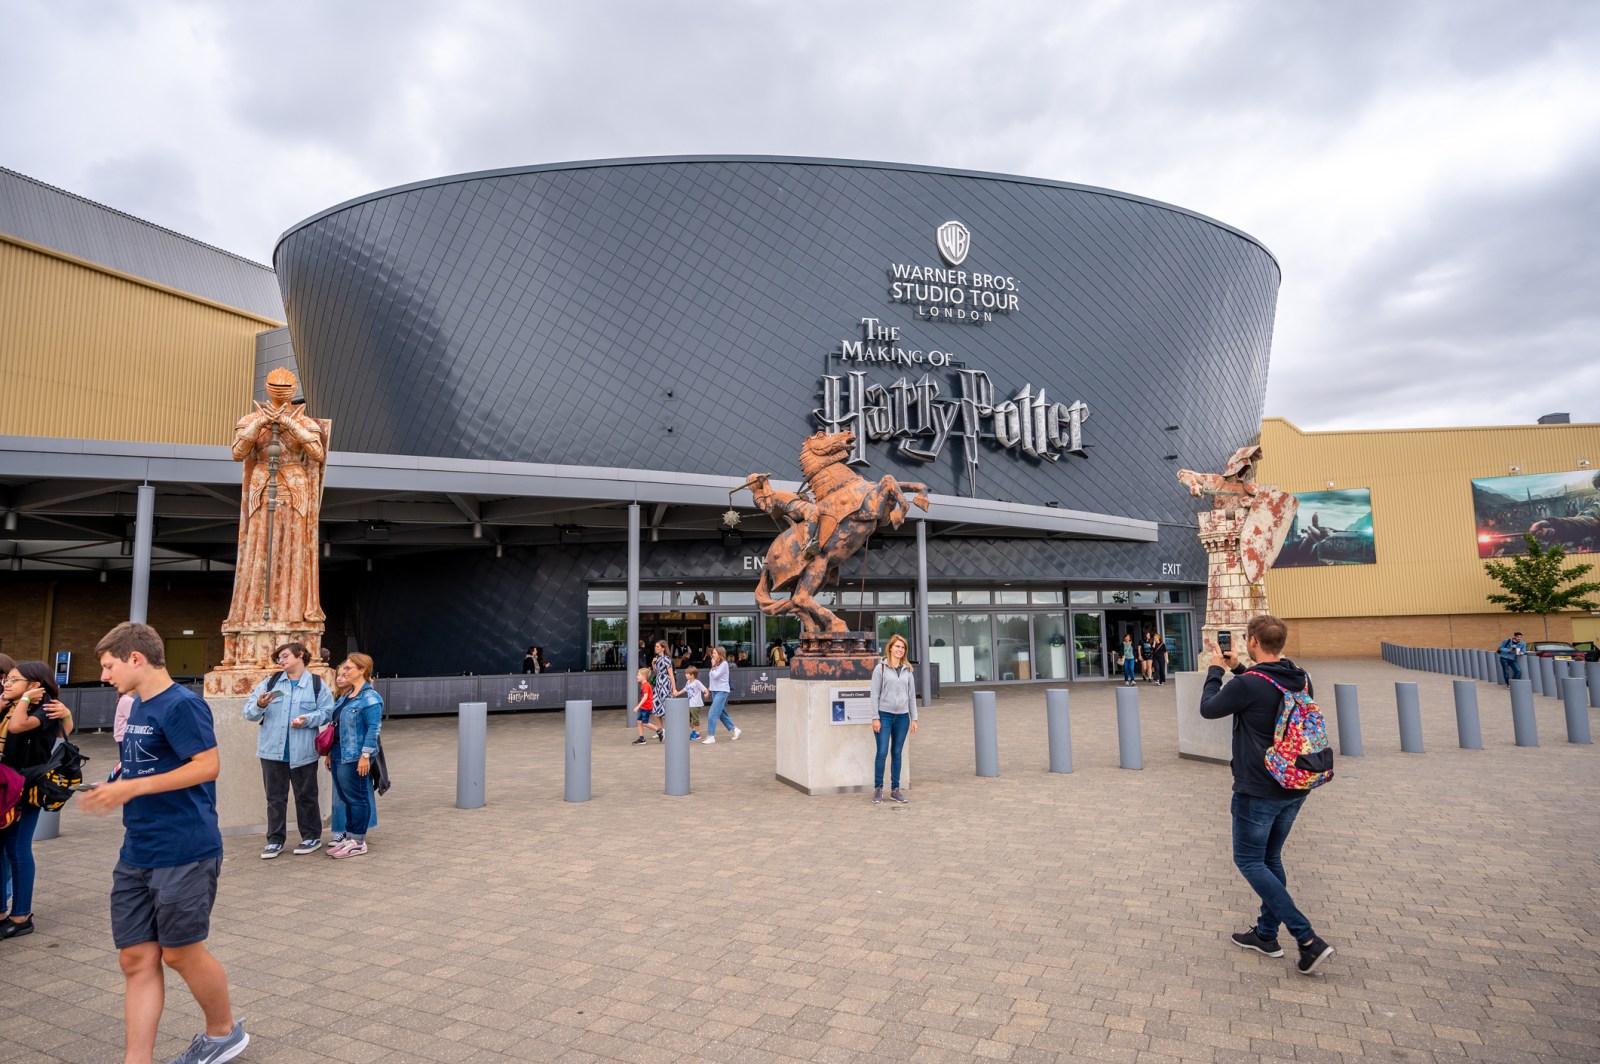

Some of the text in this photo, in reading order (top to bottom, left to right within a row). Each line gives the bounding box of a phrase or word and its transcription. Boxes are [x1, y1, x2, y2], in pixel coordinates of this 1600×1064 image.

[892, 263, 1020, 292] WARNER BROS.
[892, 282, 1019, 311] STUDIO TOUR
[919, 305, 992, 322] LONDON
[812, 368, 1091, 498] Harry Potter
[1162, 563, 1181, 575] EXIT
